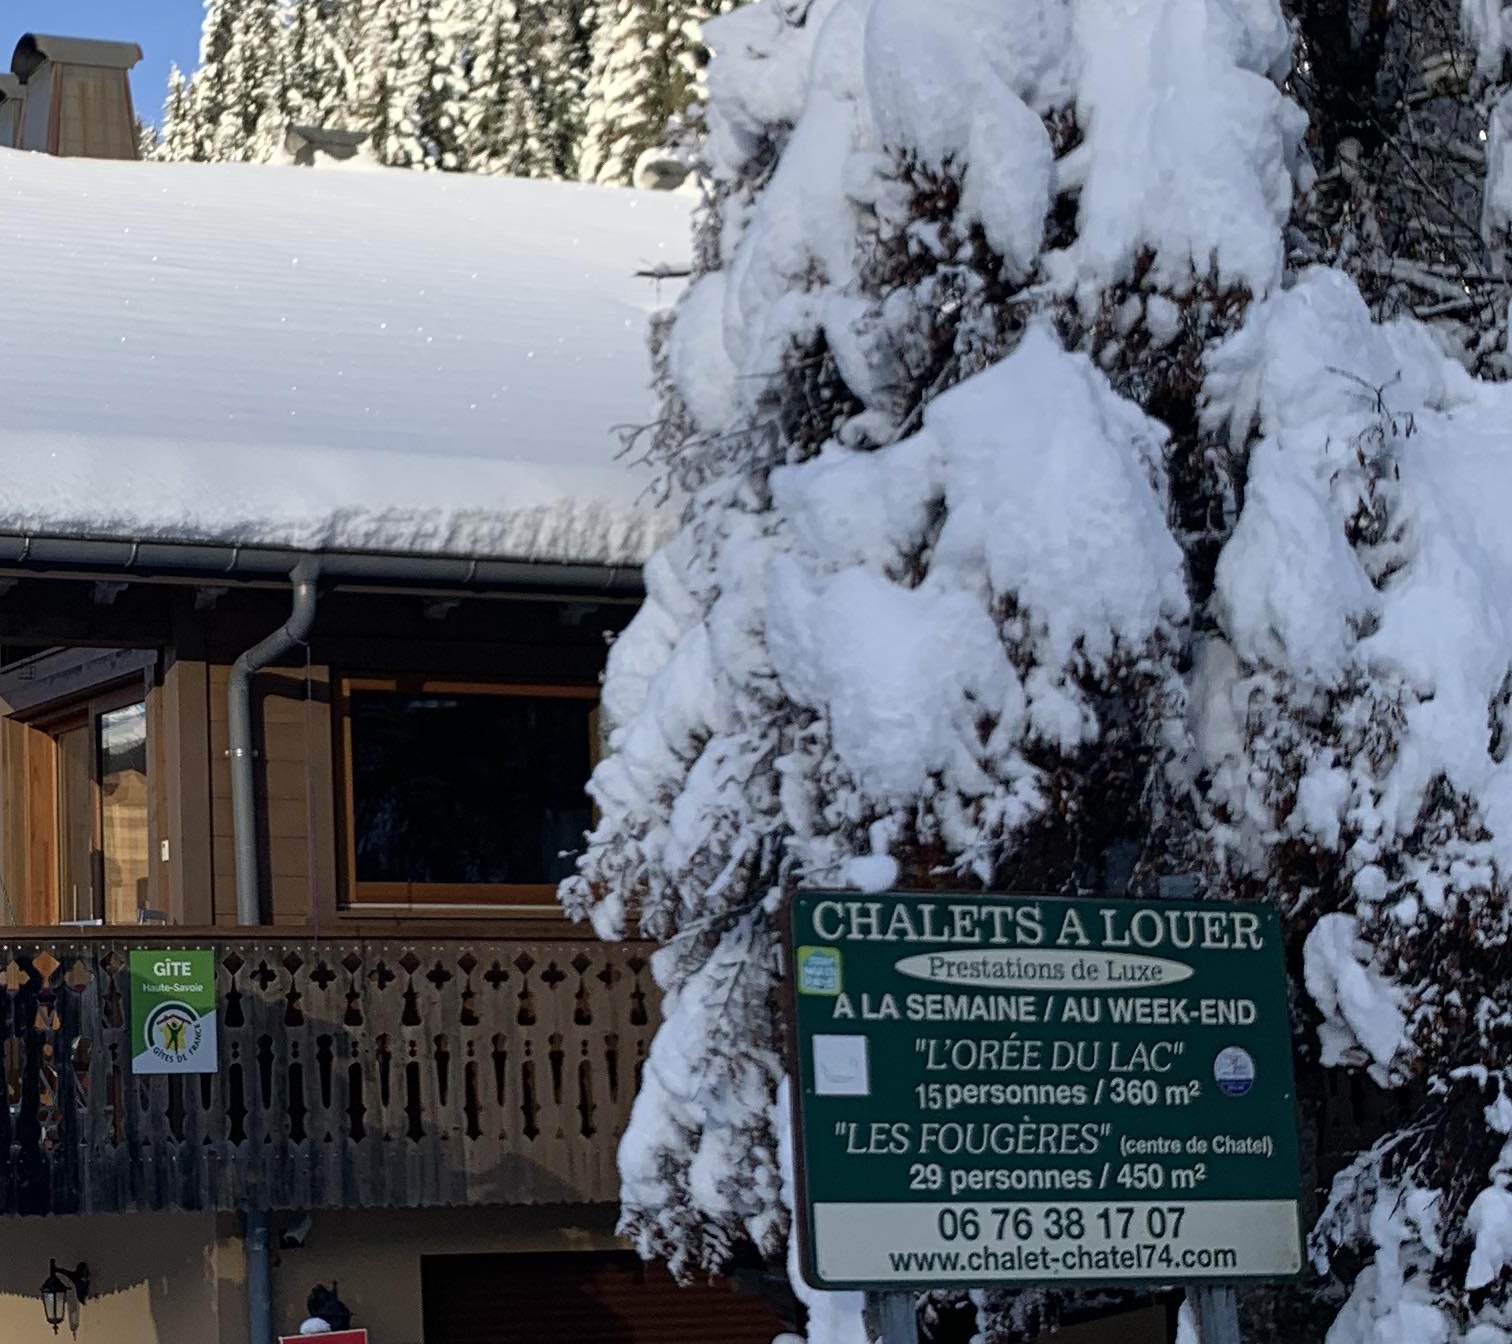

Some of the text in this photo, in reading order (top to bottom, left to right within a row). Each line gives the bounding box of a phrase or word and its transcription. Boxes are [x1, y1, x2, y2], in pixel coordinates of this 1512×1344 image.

[812, 900, 1264, 950] CHALETS A LOUER
[153, 958, 192, 976] GÎTE
[929, 956, 1163, 982] Prestations de Luxe
[142, 983, 204, 993] Haute-Savoie
[832, 991, 1257, 1026] A LA SEMAINE / AU WEEK-END
[153, 1023, 202, 1064] GÎTES DE FRANCE
[1050, 1040, 1100, 1072] DU
[1109, 1041, 1184, 1073] LAC"
[915, 1083, 942, 1110] 15
[945, 1082, 1087, 1109] personnes
[1093, 1078, 1105, 1106] /
[1109, 1077, 1157, 1106] 360
[1165, 1079, 1202, 1106] m²
[835, 1114, 1273, 1158] "LES FOUGÈRES" (centre de Chatel)
[909, 1162, 1208, 1196] 29 personnes / 450 m²
[938, 1207, 1185, 1241] 06 76 38 17 07
[890, 1244, 1237, 1273] www.chalet-chatel74.com
